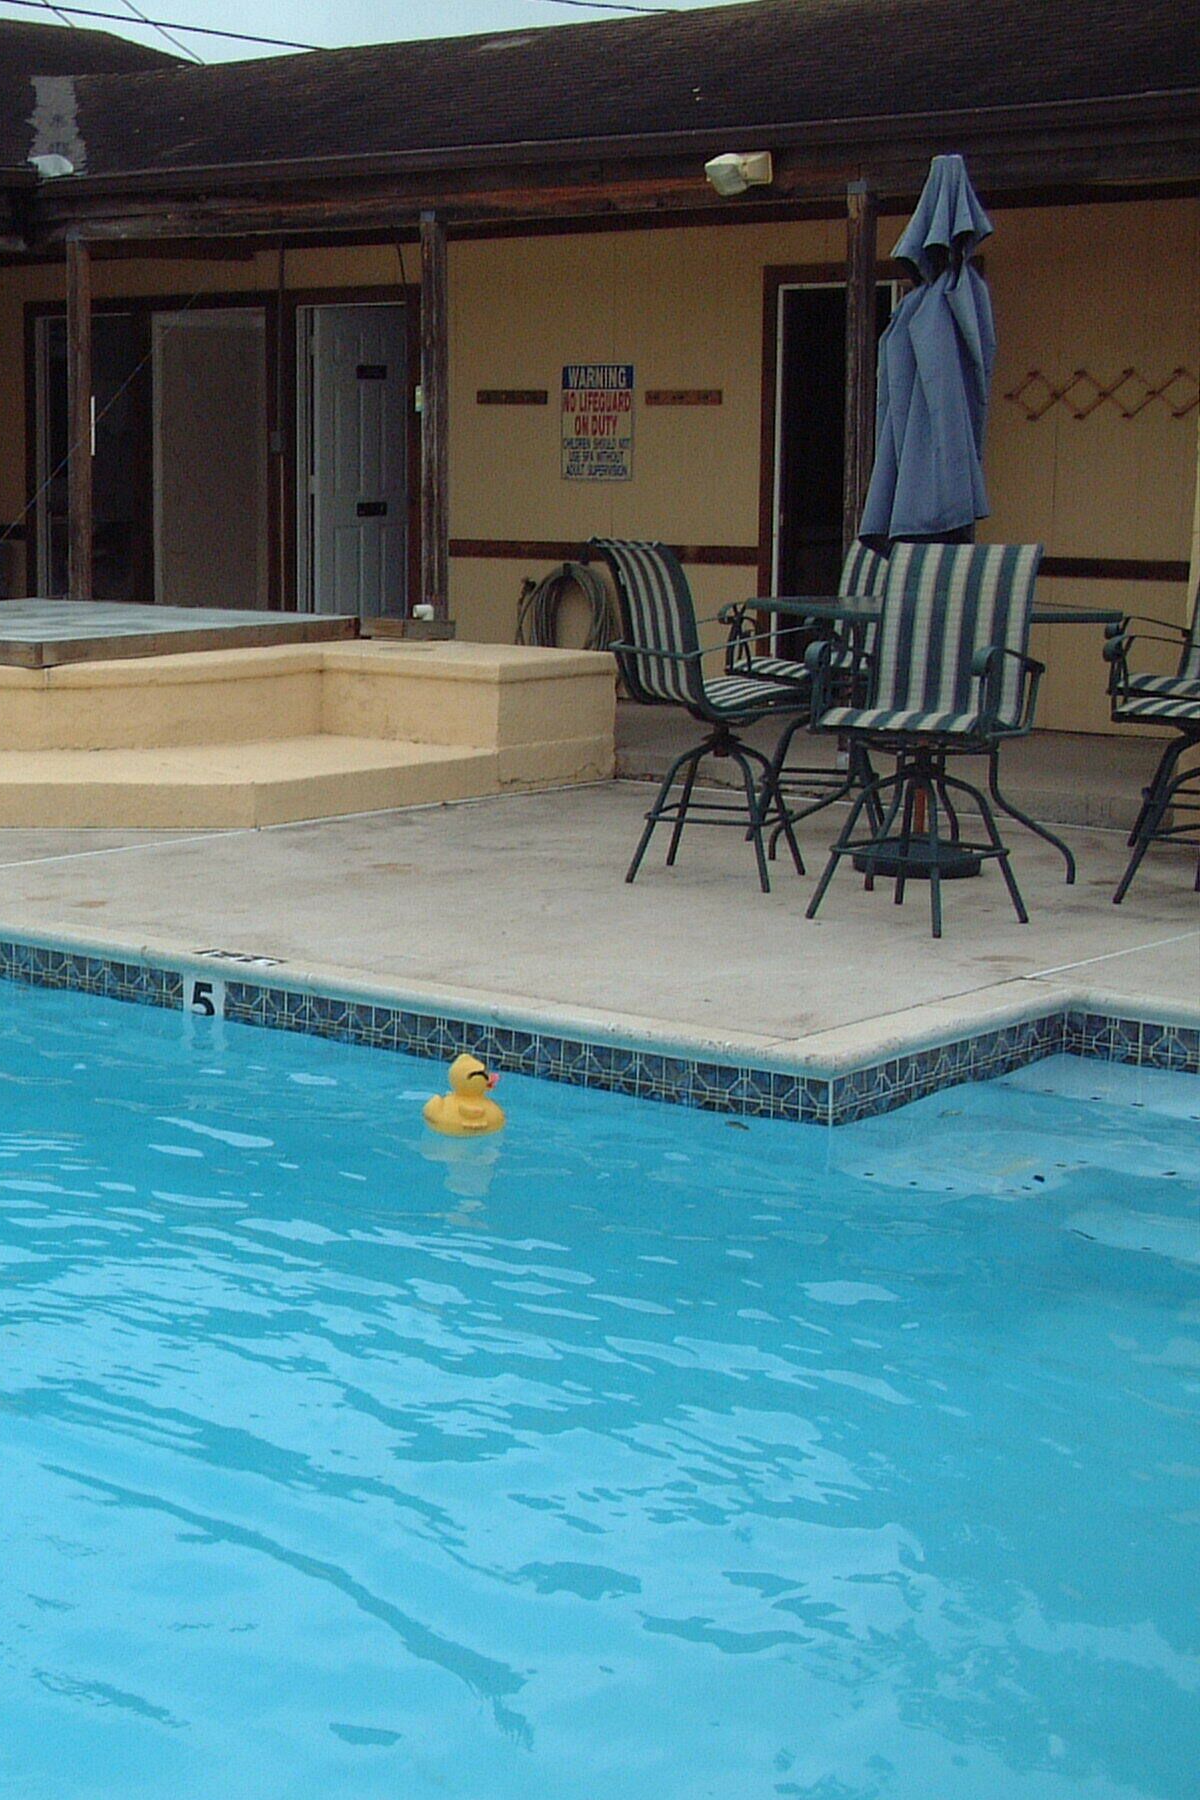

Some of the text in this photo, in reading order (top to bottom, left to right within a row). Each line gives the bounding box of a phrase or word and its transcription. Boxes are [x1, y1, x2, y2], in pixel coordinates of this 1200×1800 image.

[568, 366, 627, 388] WARNING
[563, 391, 631, 412] NO LIFEGUARD
[575, 415, 618, 436] ON DUTY
[563, 437, 591, 449] CHILDREN
[593, 437, 616, 449] SHOULD
[588, 464, 628, 476] SUPERVISION
[192, 981, 215, 1016] 5
